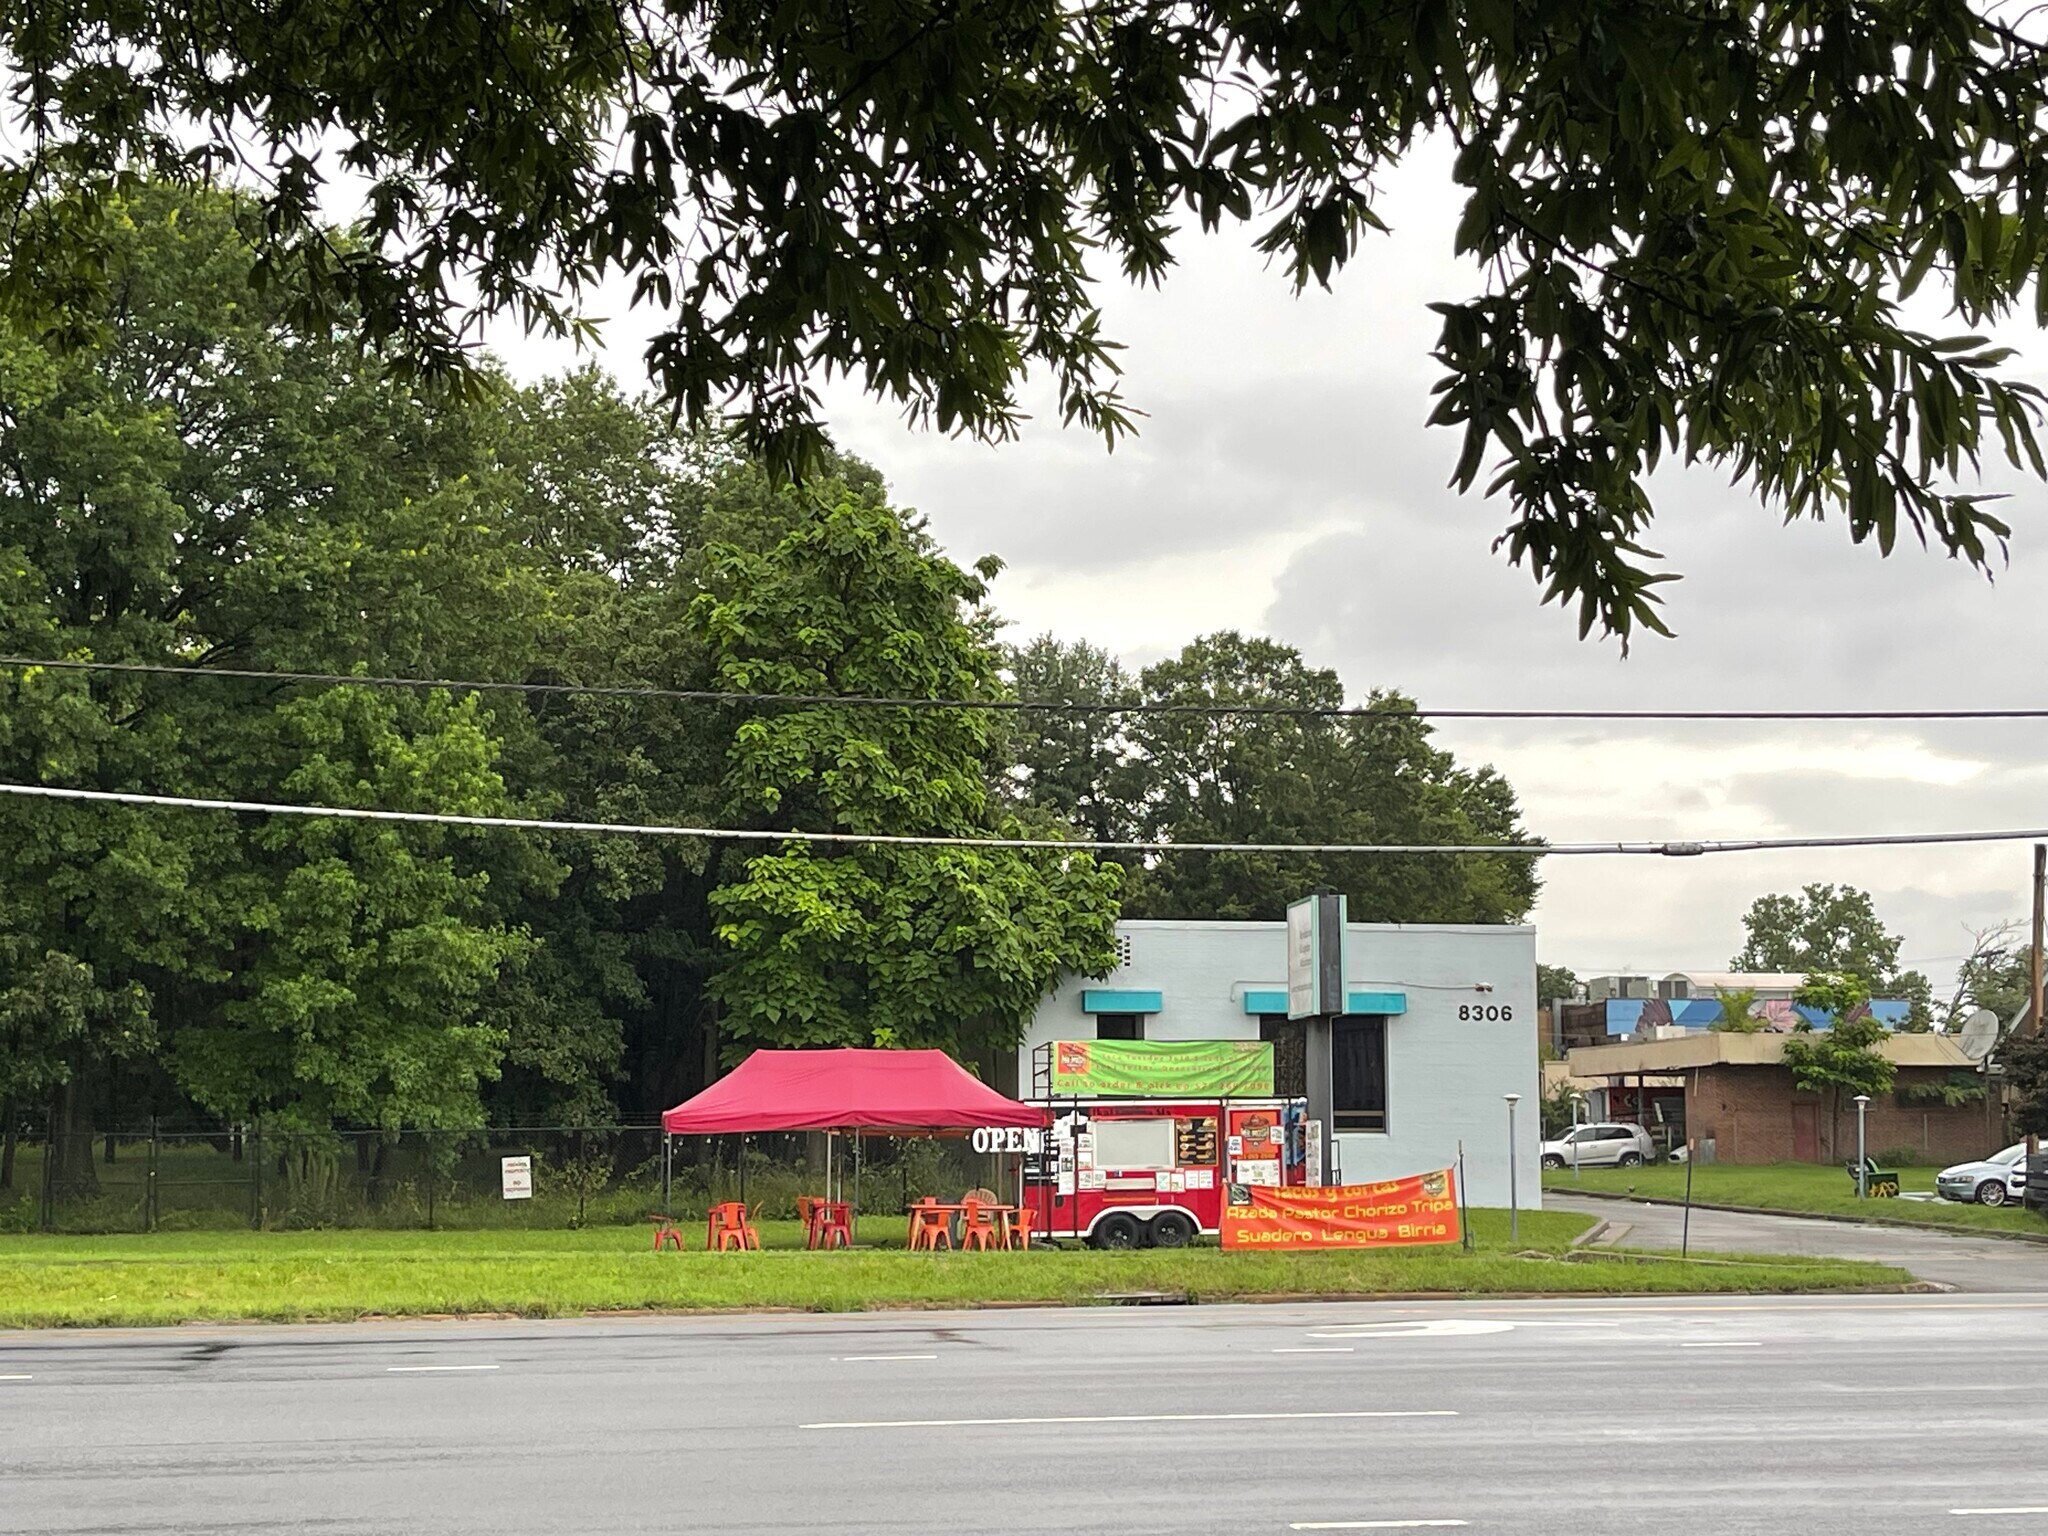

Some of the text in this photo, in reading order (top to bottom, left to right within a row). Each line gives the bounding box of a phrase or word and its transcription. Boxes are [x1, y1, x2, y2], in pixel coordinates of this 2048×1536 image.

[1459, 1004, 1513, 1022] 8306
[972, 1126, 1045, 1154] OPEN
[1226, 1199, 1454, 1220] Azada Pastor Chorizo Tripa
[1236, 1222, 1447, 1244] Suadero Lengua Birria
